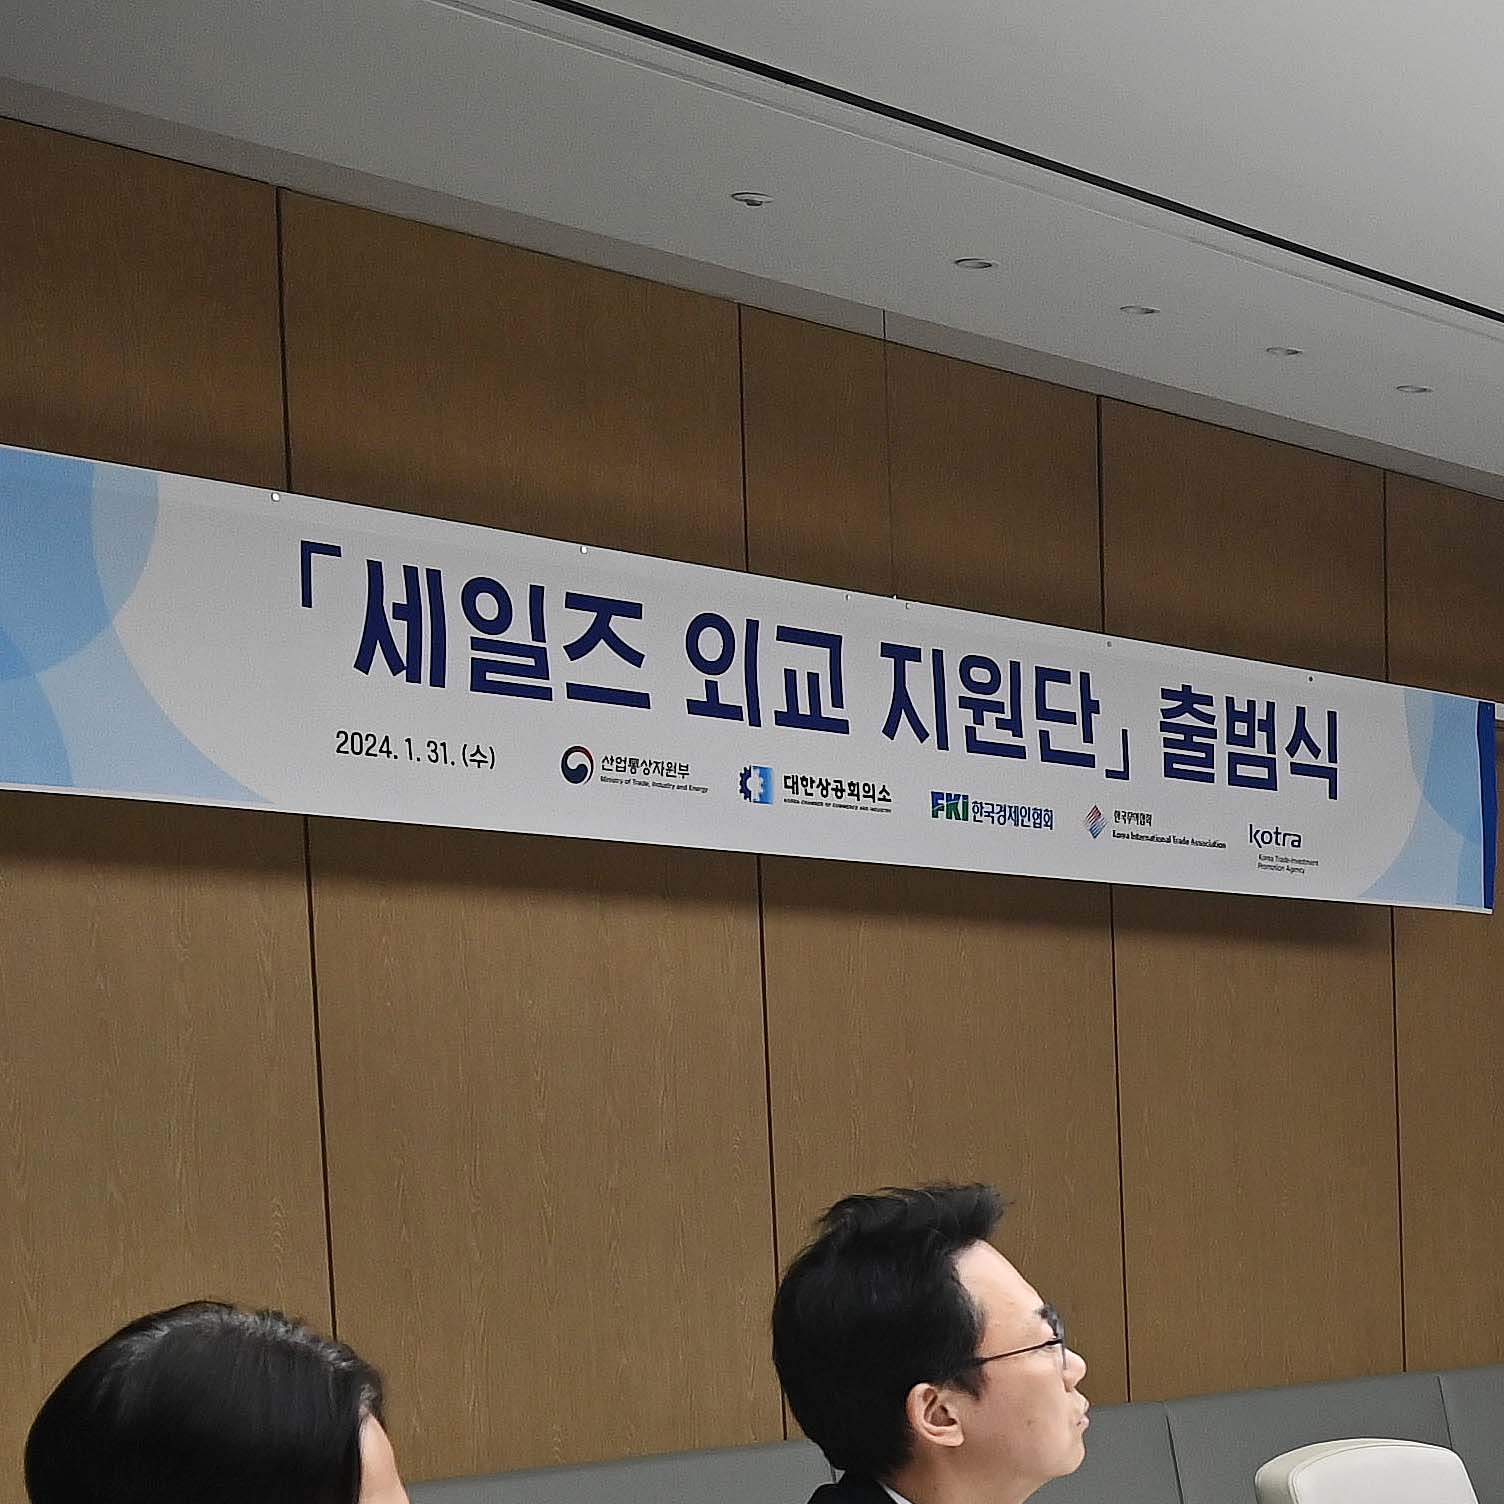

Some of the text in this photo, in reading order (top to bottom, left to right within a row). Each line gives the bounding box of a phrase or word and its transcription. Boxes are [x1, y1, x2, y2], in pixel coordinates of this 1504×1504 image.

[685, 612, 850, 736] 외교
[1158, 683, 1340, 801] 출범식
[336, 730, 495, 770] 2024. 1. 31. (수)
[601, 755, 690, 779] 산업통상자원부
[783, 774, 892, 804] 대한상공회의소
[930, 790, 1054, 831] FKI 한국경제인협회
[1249, 823, 1302, 848] kotra
